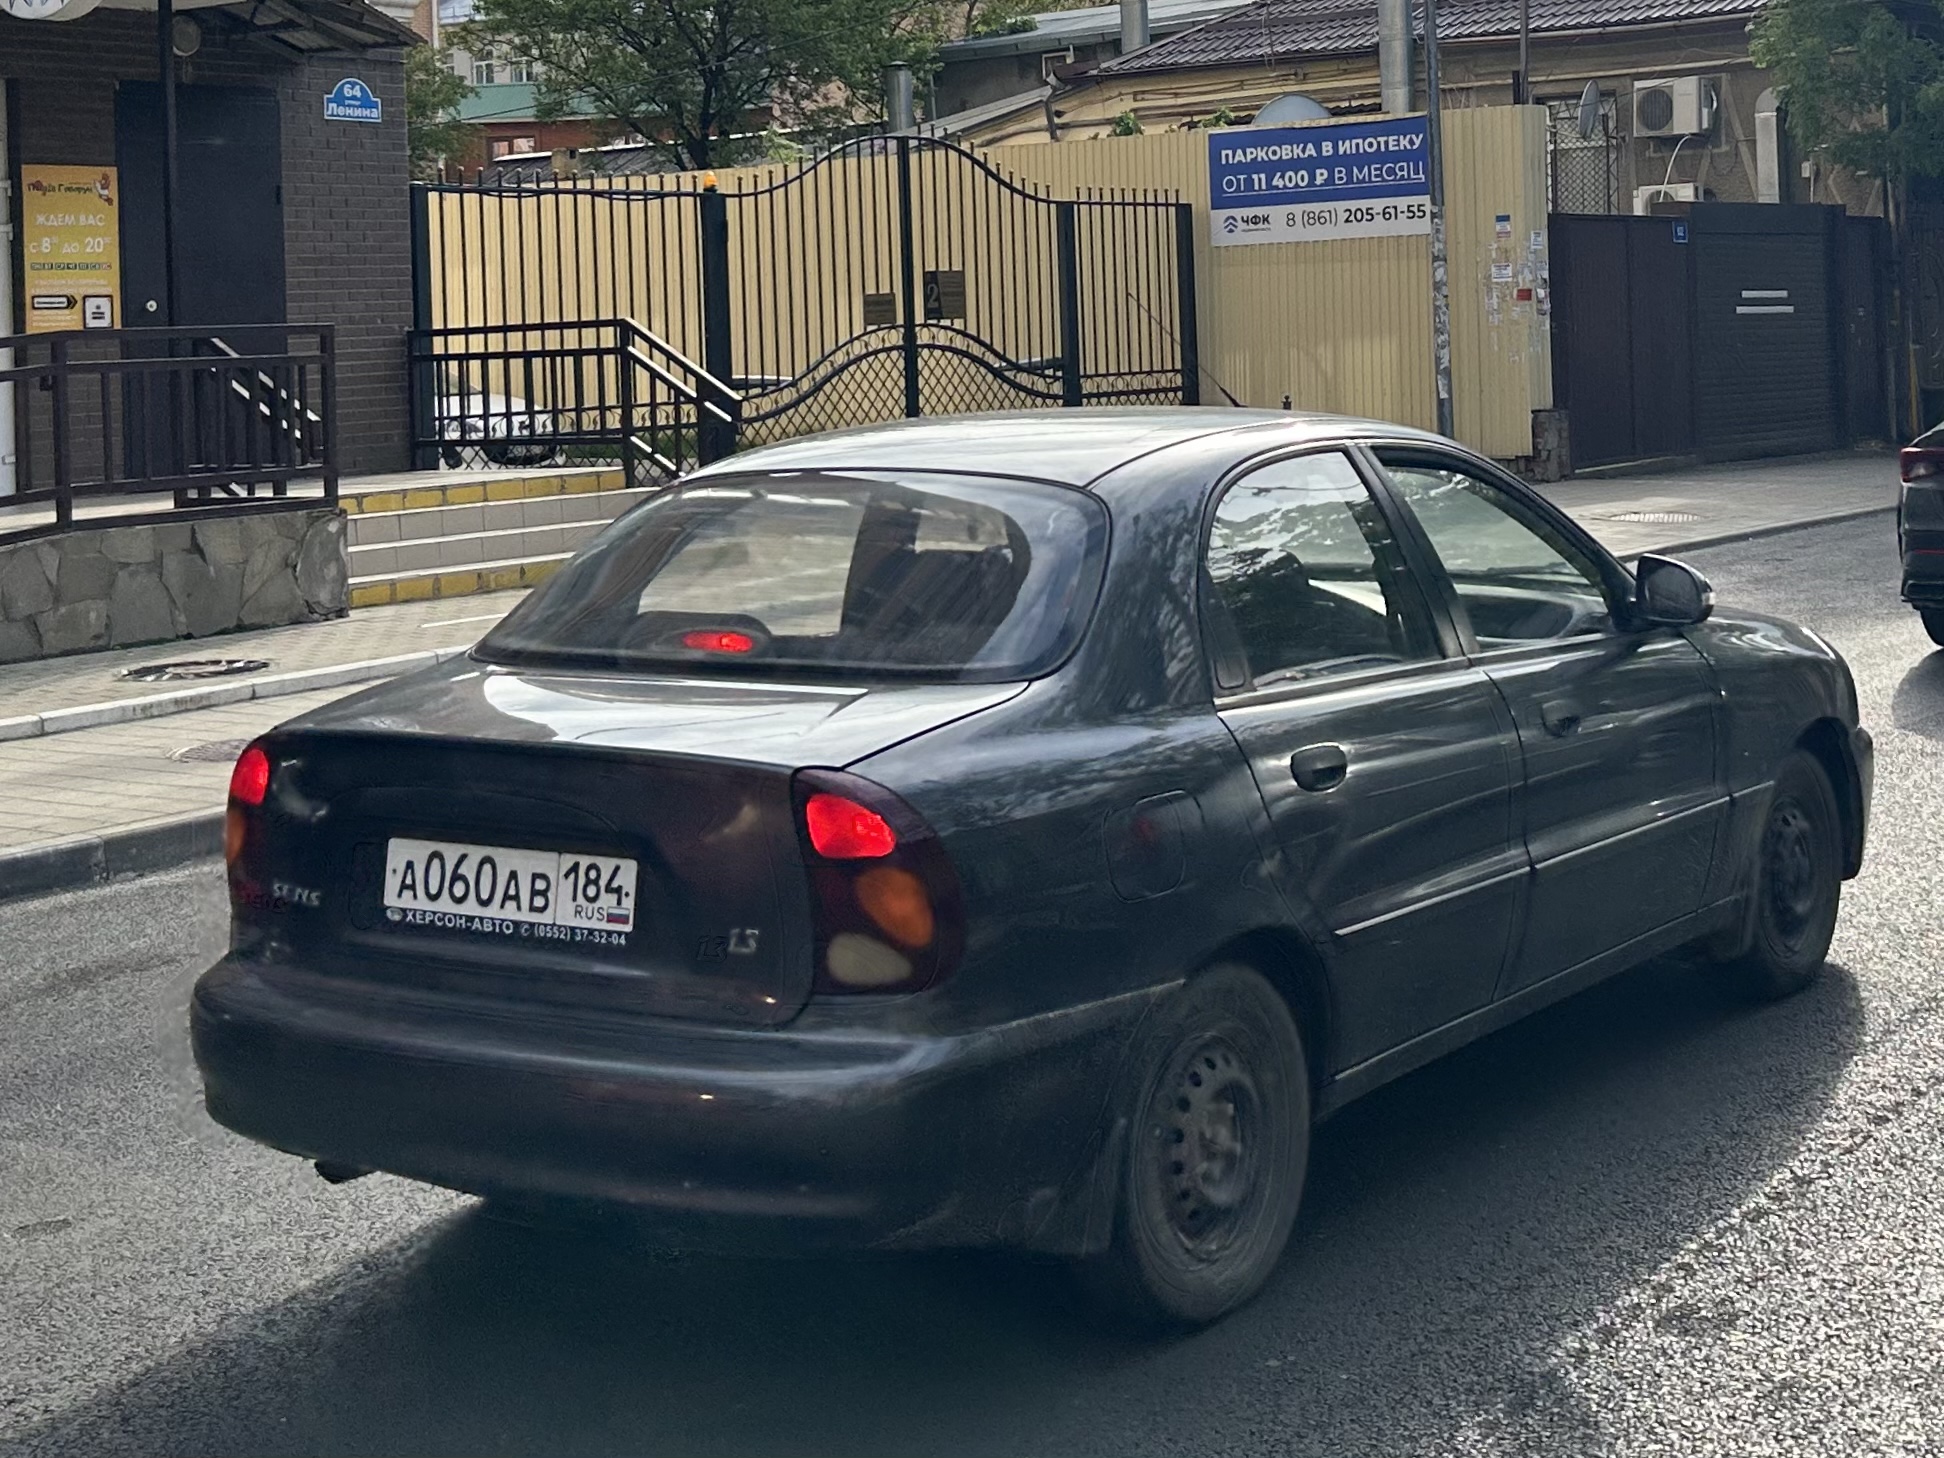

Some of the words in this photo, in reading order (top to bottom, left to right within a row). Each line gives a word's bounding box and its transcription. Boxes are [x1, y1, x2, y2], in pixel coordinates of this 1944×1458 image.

[343, 84, 362, 98] 64
[327, 103, 379, 118] Ленина
[1221, 142, 1318, 165] ПАРКОВКА
[1321, 141, 1334, 157] В
[1338, 133, 1424, 156] ИПОТЕКУ
[1222, 174, 1248, 192] ОТ
[1252, 173, 1267, 190] 11
[1272, 169, 1309, 188] 400
[1334, 167, 1347, 184] В
[1352, 161, 1426, 183] МЕСЯЦ
[79, 213, 105, 227] ВАС
[1241, 214, 1271, 226] ЧФК
[1286, 212, 1296, 227] 8
[1301, 207, 1338, 229] (861)
[1343, 203, 1427, 224] 205-61-55
[927, 283, 938, 308] 2
[563, 861, 623, 906] 184
[574, 904, 605, 921] RUS
[405, 909, 514, 935] ХЕРСОН-АВТО
[534, 924, 571, 941] (0552)
[574, 929, 627, 946] 37-32-04
